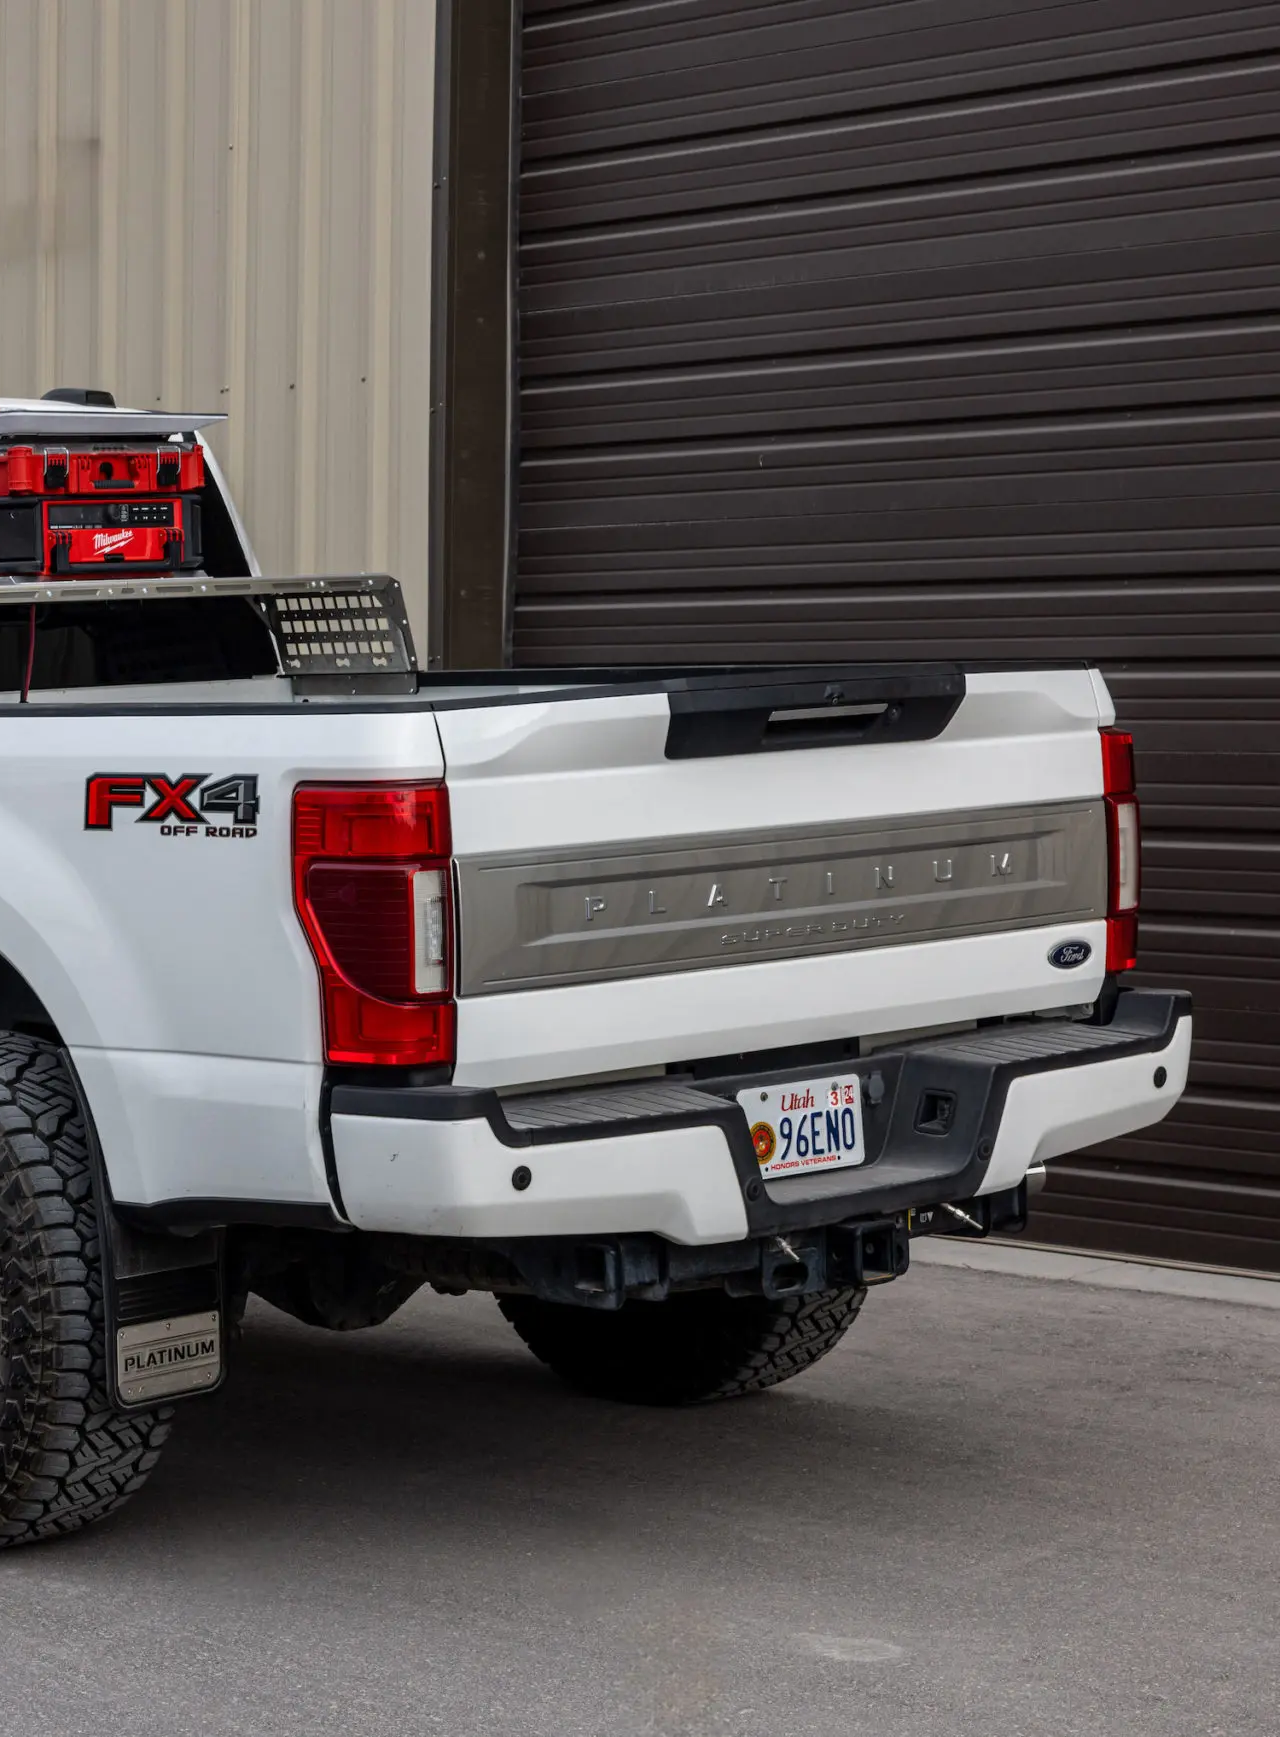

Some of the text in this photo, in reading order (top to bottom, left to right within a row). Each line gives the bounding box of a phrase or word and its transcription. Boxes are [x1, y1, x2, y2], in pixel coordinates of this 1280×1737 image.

[92, 529, 134, 550] Milwaukee
[83, 772, 260, 831] FX4
[160, 825, 257, 839] OFF ROAD
[585, 853, 1014, 921] PLATINUM
[721, 914, 904, 945] SUPER DUTY
[1060, 946, 1085, 963] Ford
[781, 1088, 815, 1111] Utah
[830, 1091, 838, 1105] 3
[770, 1154, 836, 1171] HONORS VETERANS
[124, 1339, 215, 1372] PLATINUM
